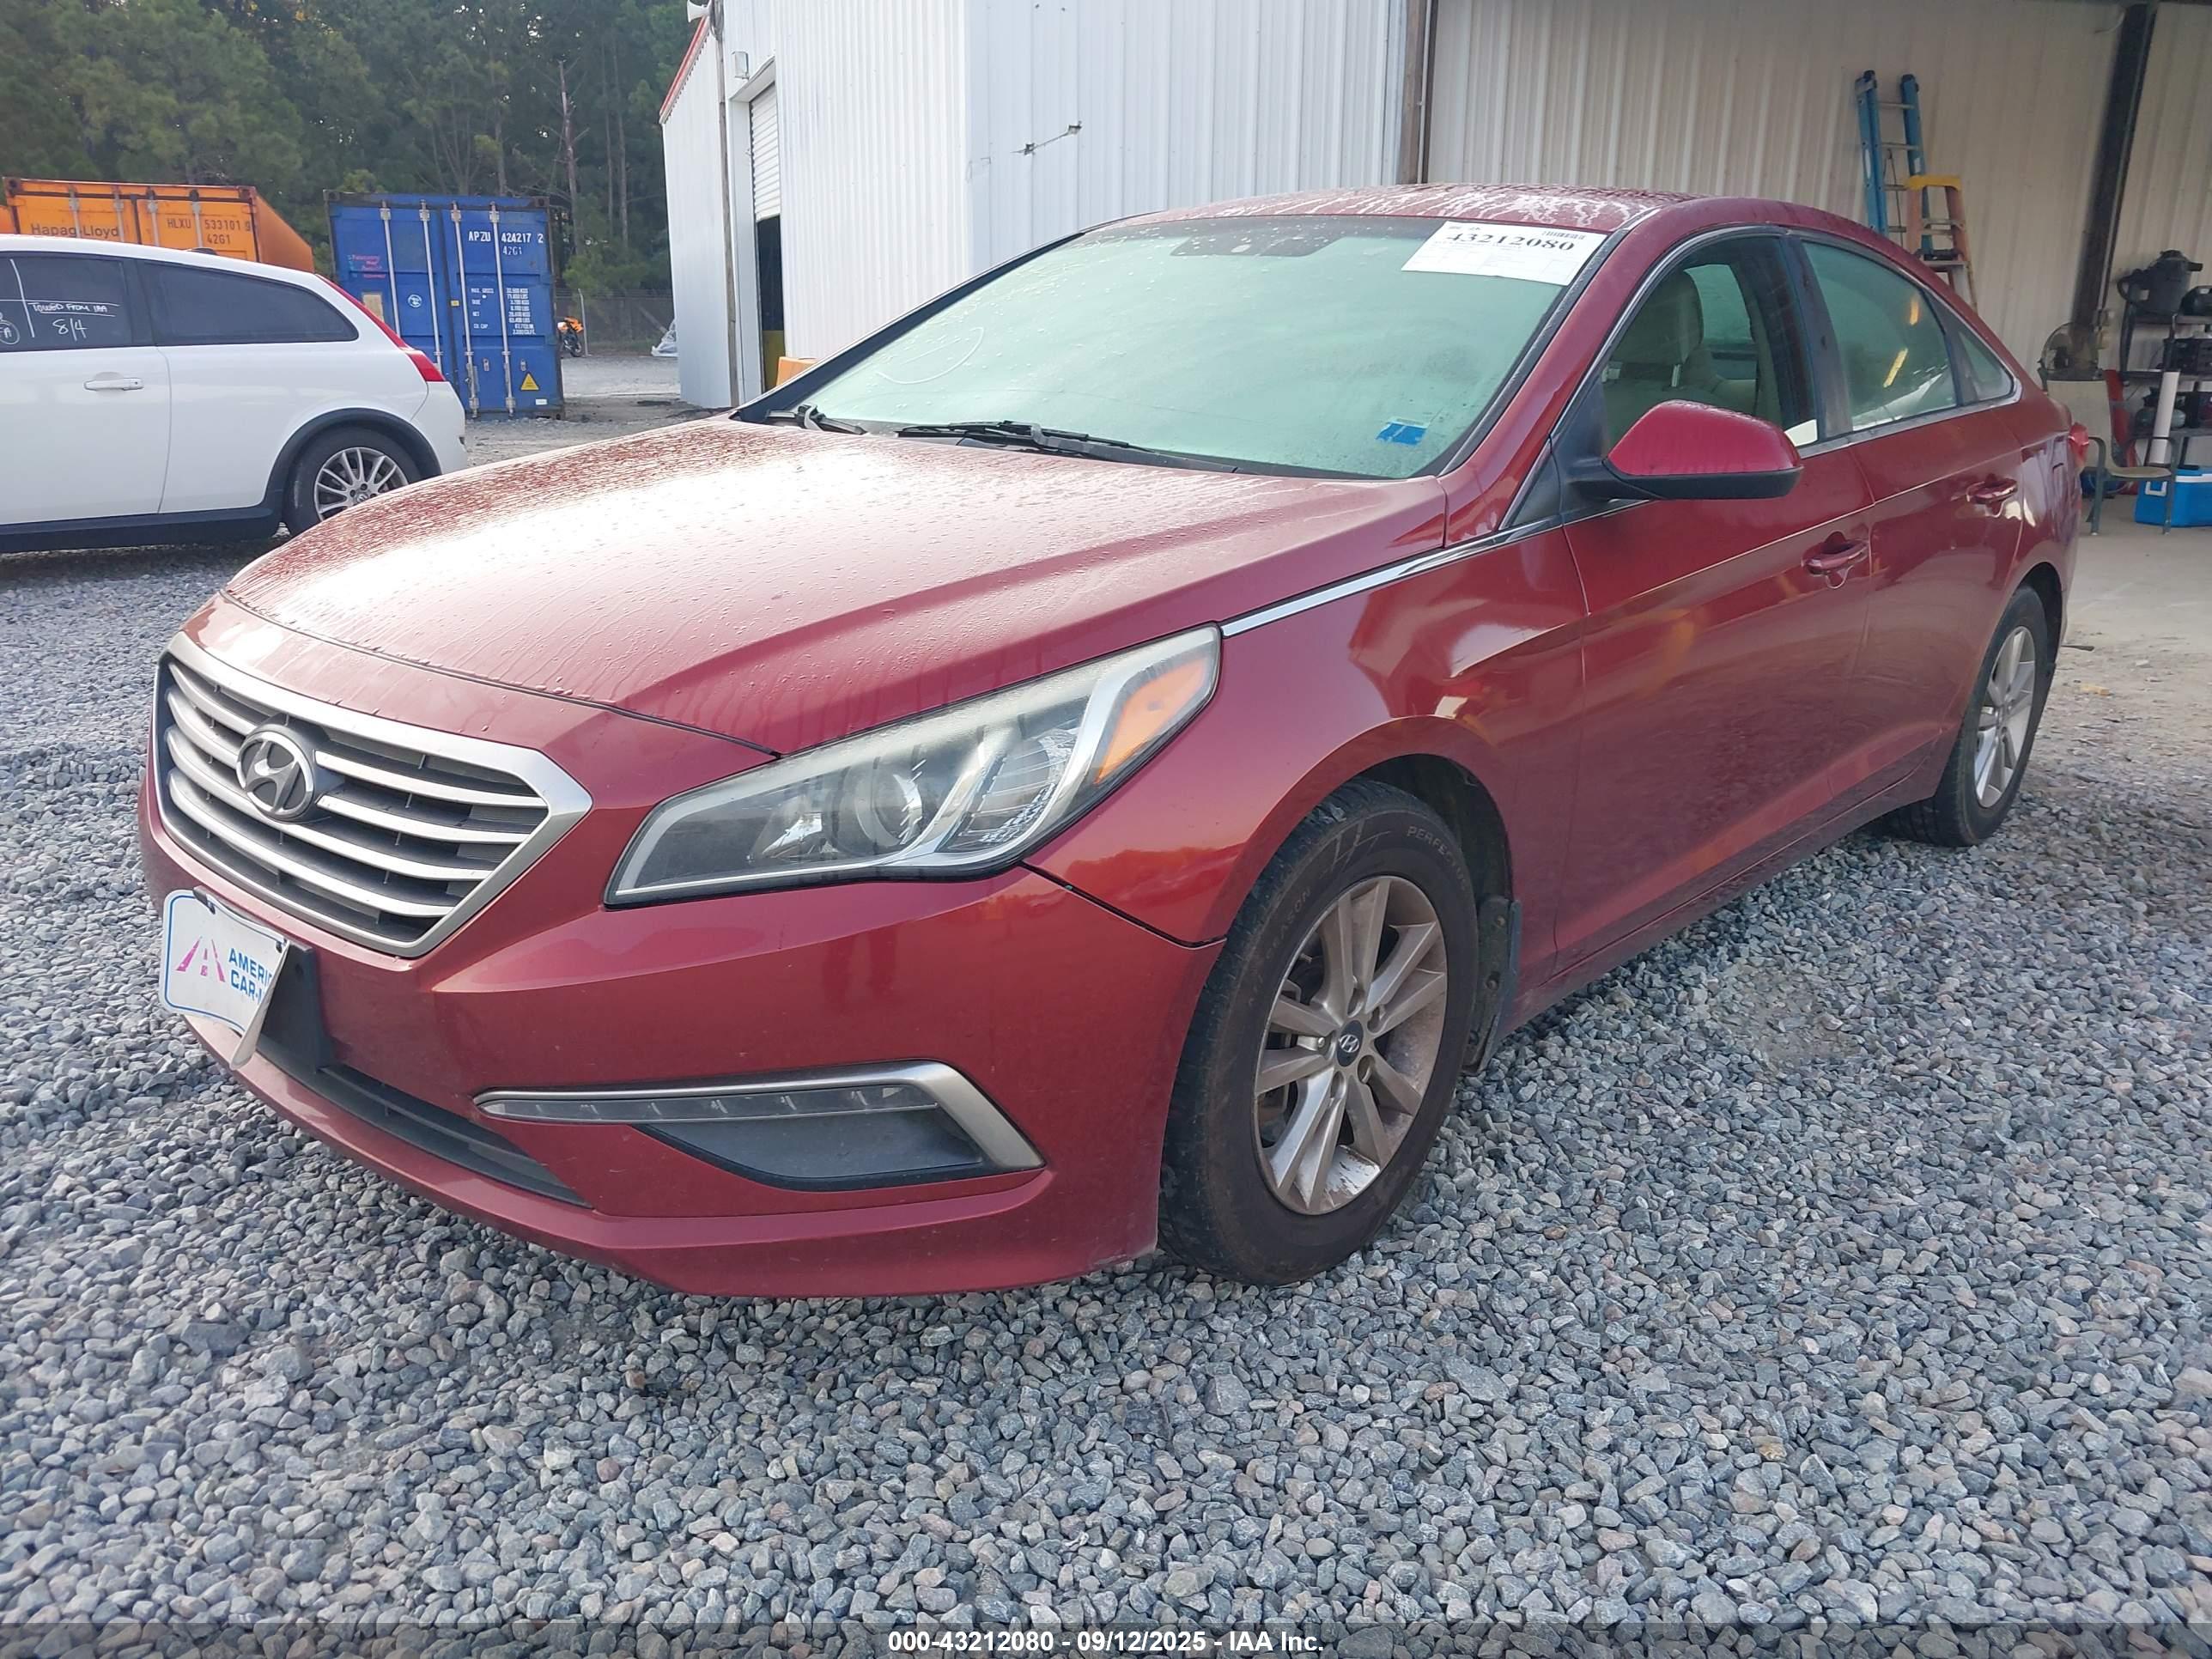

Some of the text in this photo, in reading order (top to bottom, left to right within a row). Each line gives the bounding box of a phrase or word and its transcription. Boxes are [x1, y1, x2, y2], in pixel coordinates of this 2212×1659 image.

[167, 218, 191, 228] HLXU
[204, 219, 240, 230] 533101
[468, 231, 544, 243] APZU 424217 2
[1447, 233, 1575, 251] 43212080
